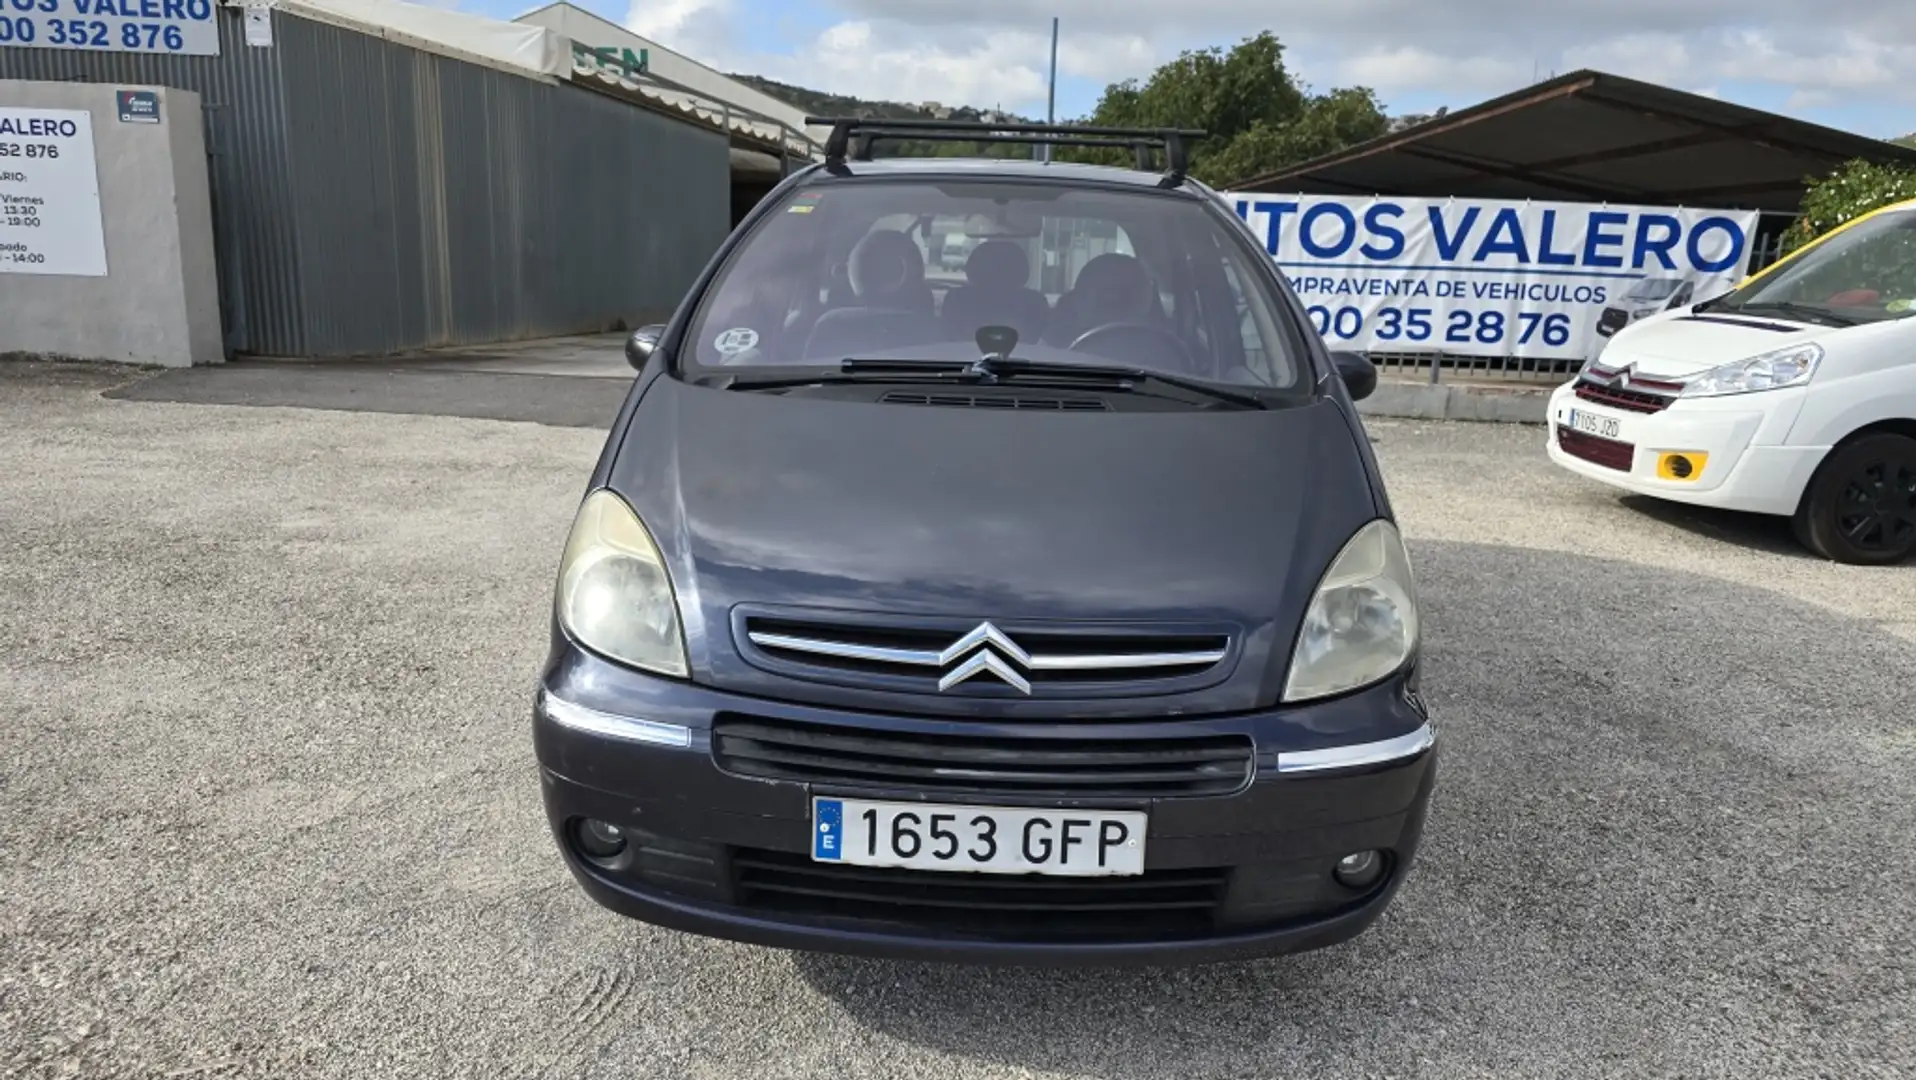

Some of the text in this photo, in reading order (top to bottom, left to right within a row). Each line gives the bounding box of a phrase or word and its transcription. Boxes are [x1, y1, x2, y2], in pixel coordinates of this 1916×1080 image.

[75, 0, 211, 20] VALERO
[47, 19, 109, 46] 352
[121, 23, 183, 50] 876
[26, 144, 59, 158] 876
[0, 171, 27, 182] RIO:
[1236, 200, 1745, 272] TOS VALERO
[1436, 281, 1466, 298] DE
[1473, 282, 1607, 304] VEHICULOS
[1375, 307, 1432, 341] 35
[1445, 309, 1504, 344] 28
[1517, 312, 1570, 346] 76
[823, 809, 1129, 867] E 1653 GFP
